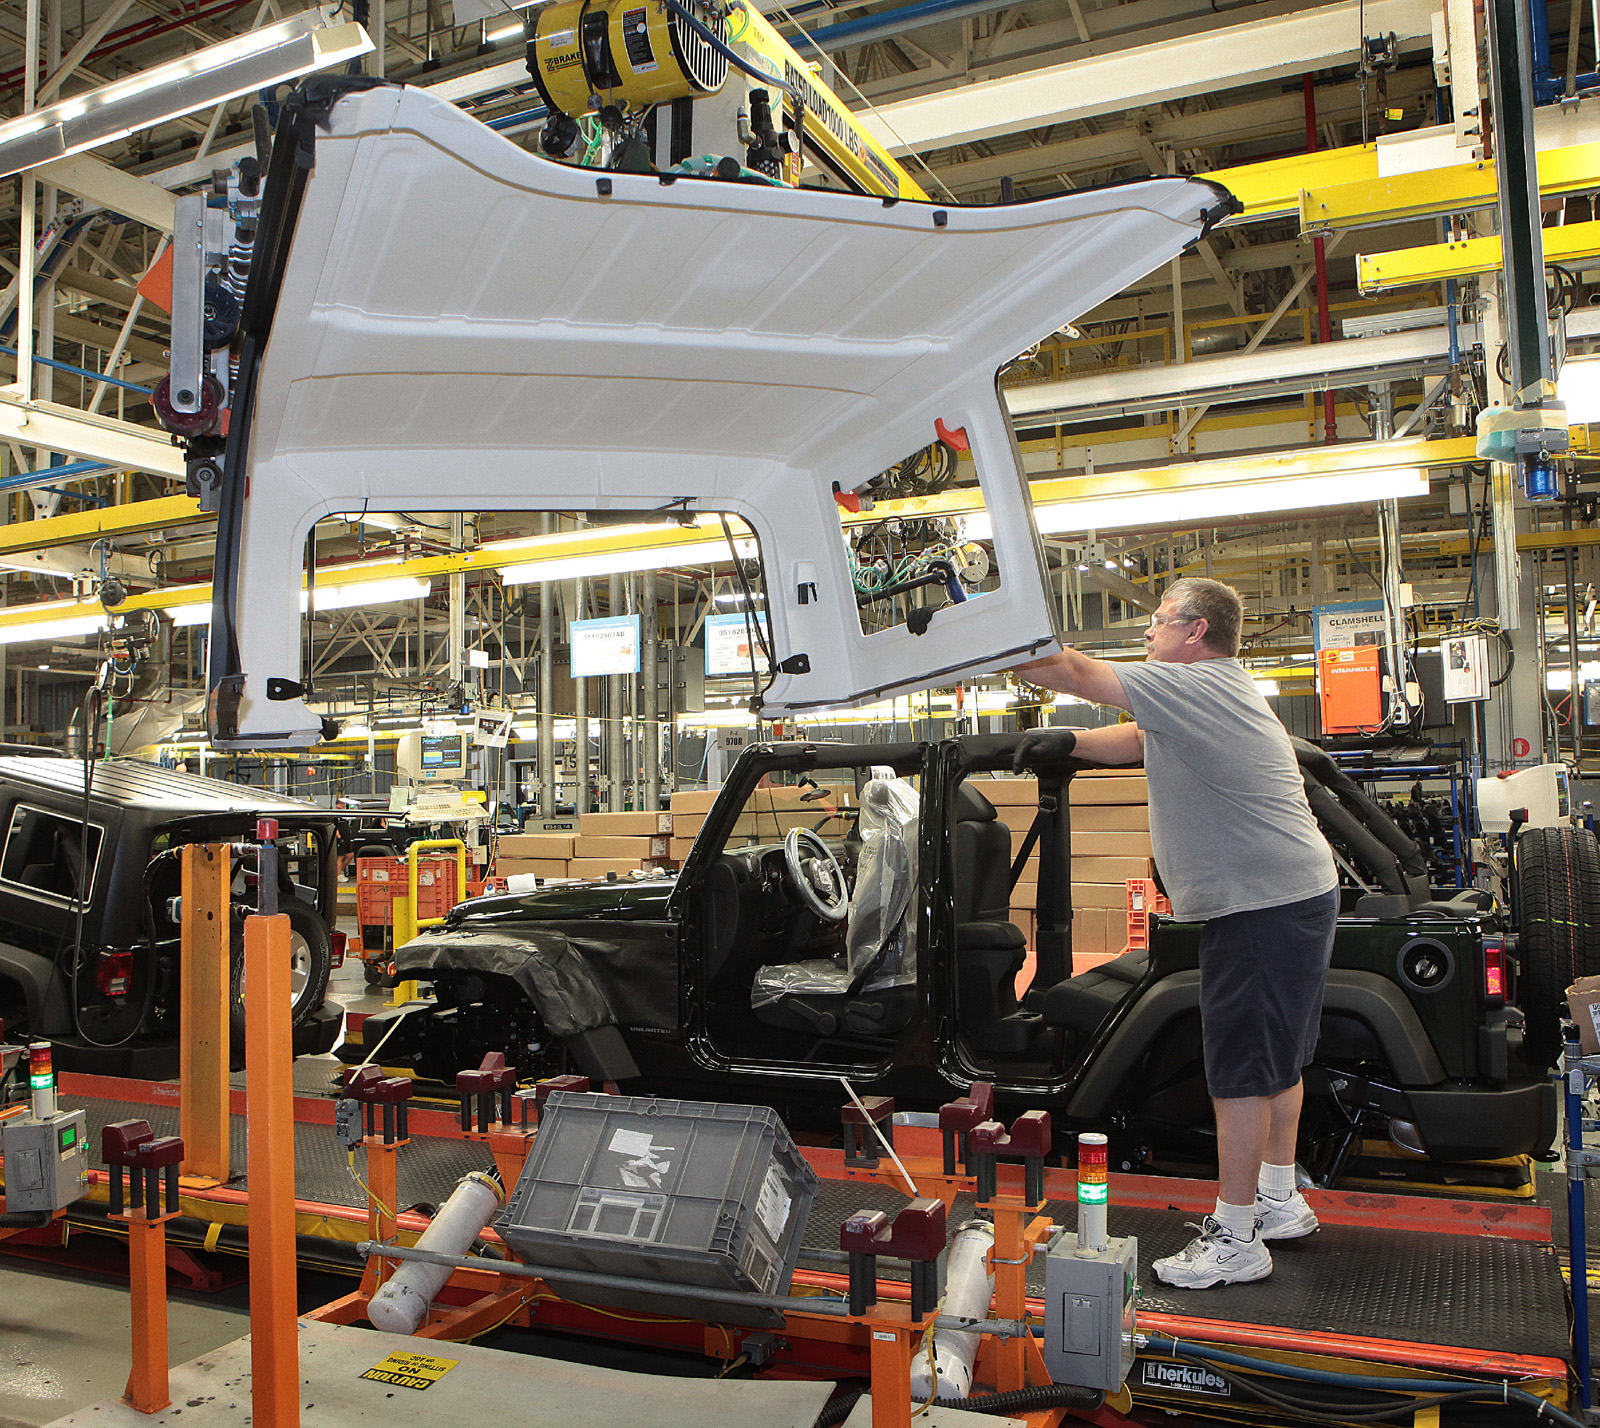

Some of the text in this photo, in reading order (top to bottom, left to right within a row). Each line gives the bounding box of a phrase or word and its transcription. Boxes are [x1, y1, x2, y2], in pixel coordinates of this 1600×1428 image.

[807, 81, 826, 125] LOAD
[843, 118, 859, 158] LBS
[1329, 615, 1385, 626] CLAMSHELL
[630, 1026, 671, 1034] UNLIMITED
[398, 1366, 421, 1374] NO
[1157, 1364, 1225, 1388] herkules
[363, 1369, 430, 1389] CAUTION
